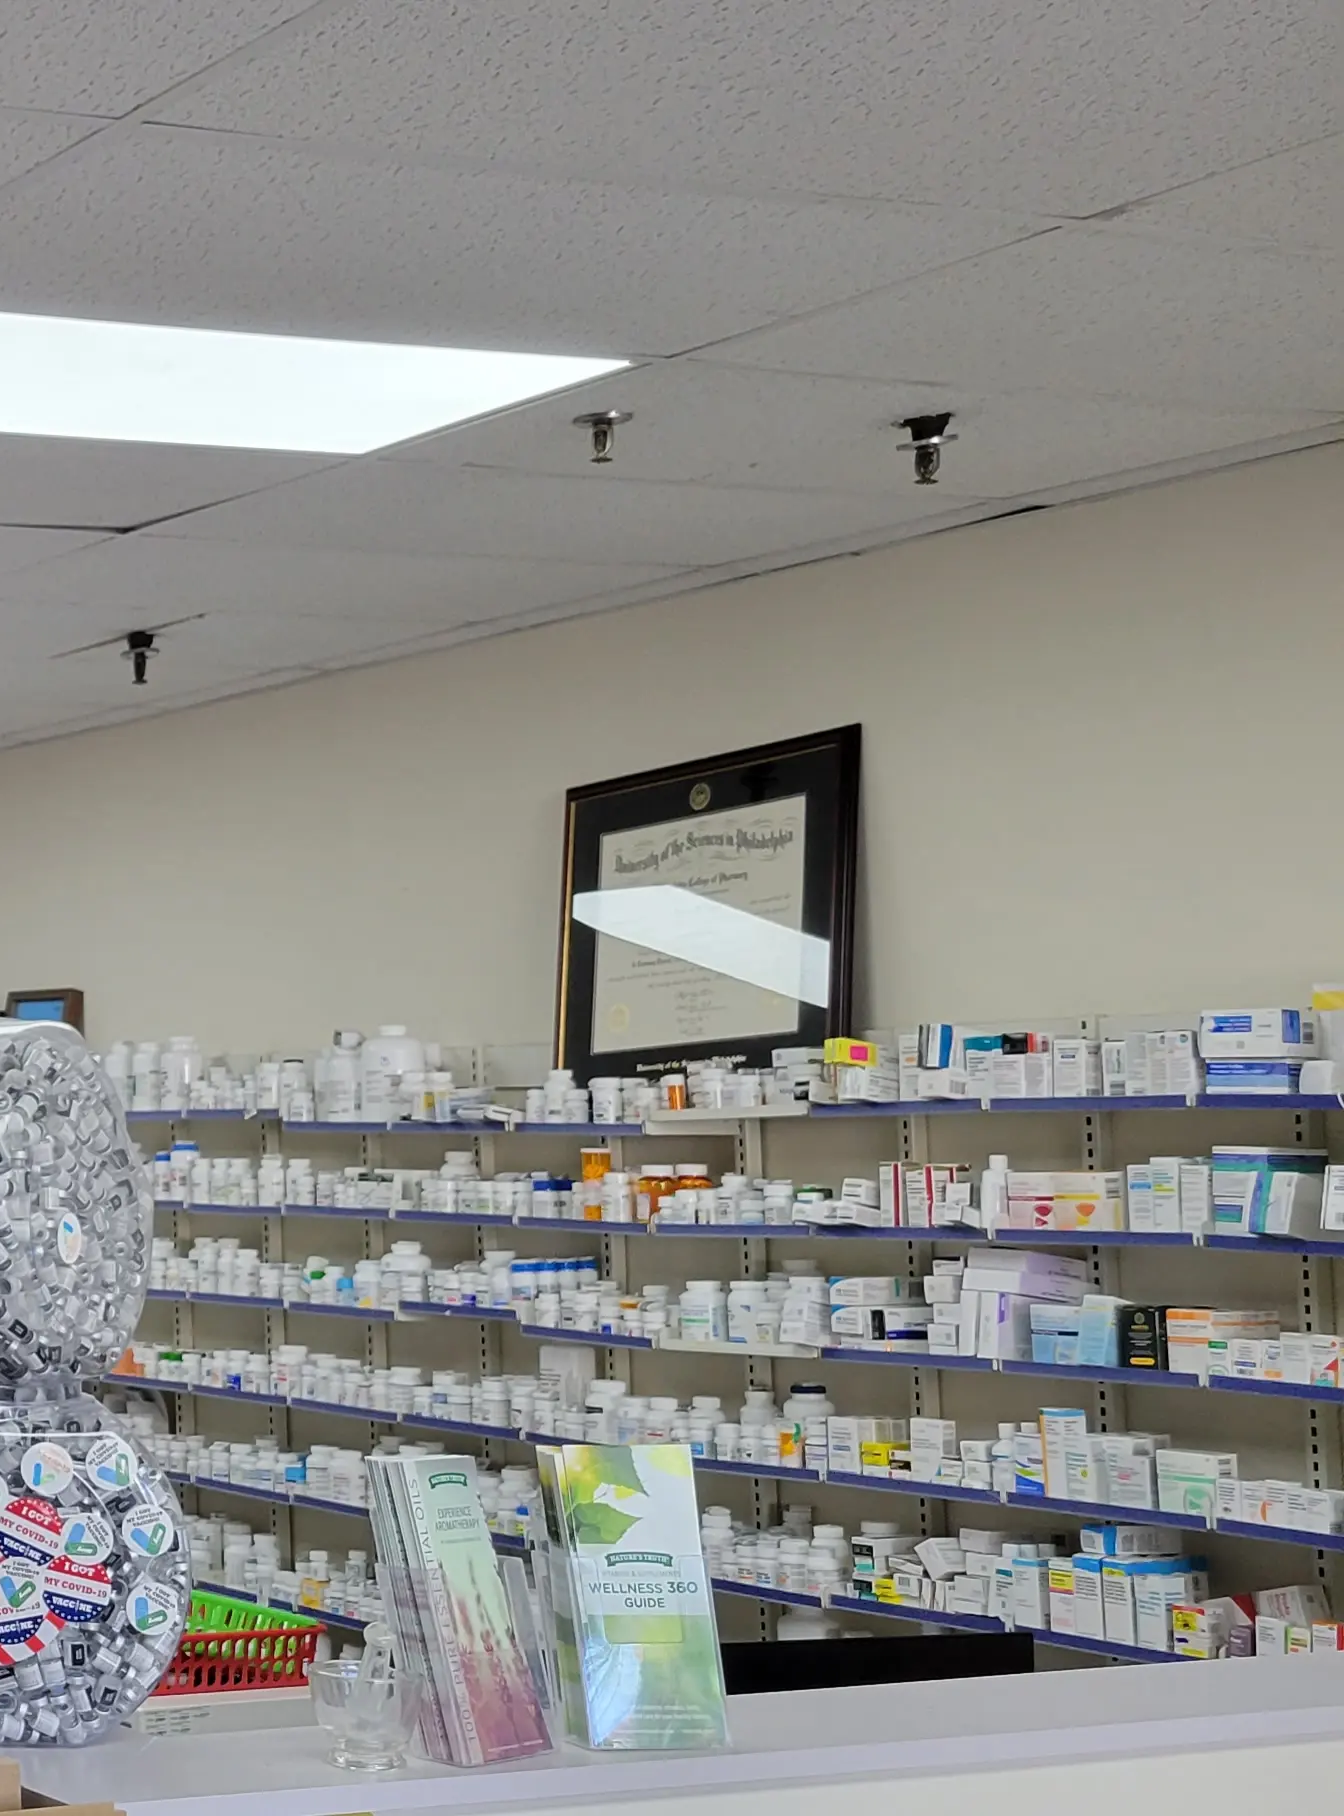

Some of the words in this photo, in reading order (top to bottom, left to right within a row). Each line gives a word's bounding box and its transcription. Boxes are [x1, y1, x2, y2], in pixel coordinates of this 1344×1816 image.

[408, 1478, 425, 1522] OILS
[21, 1506, 29, 1515] I
[28, 1510, 53, 1526] GOT
[436, 1506, 472, 1520] EXPERIENCE
[435, 1519, 480, 1533] AROMATHERAPY
[15, 1525, 59, 1550] COVID-19
[3, 1537, 43, 1560] VACCINE
[63, 1561, 70, 1571] I
[71, 1564, 96, 1577] GOT
[421, 1527, 451, 1629] ESSENTIAL
[44, 1576, 60, 1587] MY
[61, 1581, 108, 1598] COVID-19
[588, 1582, 663, 1595] WELLNESS
[667, 1581, 699, 1594] 360
[52, 1596, 93, 1613] VACCINE
[624, 1597, 666, 1609] GUIDE
